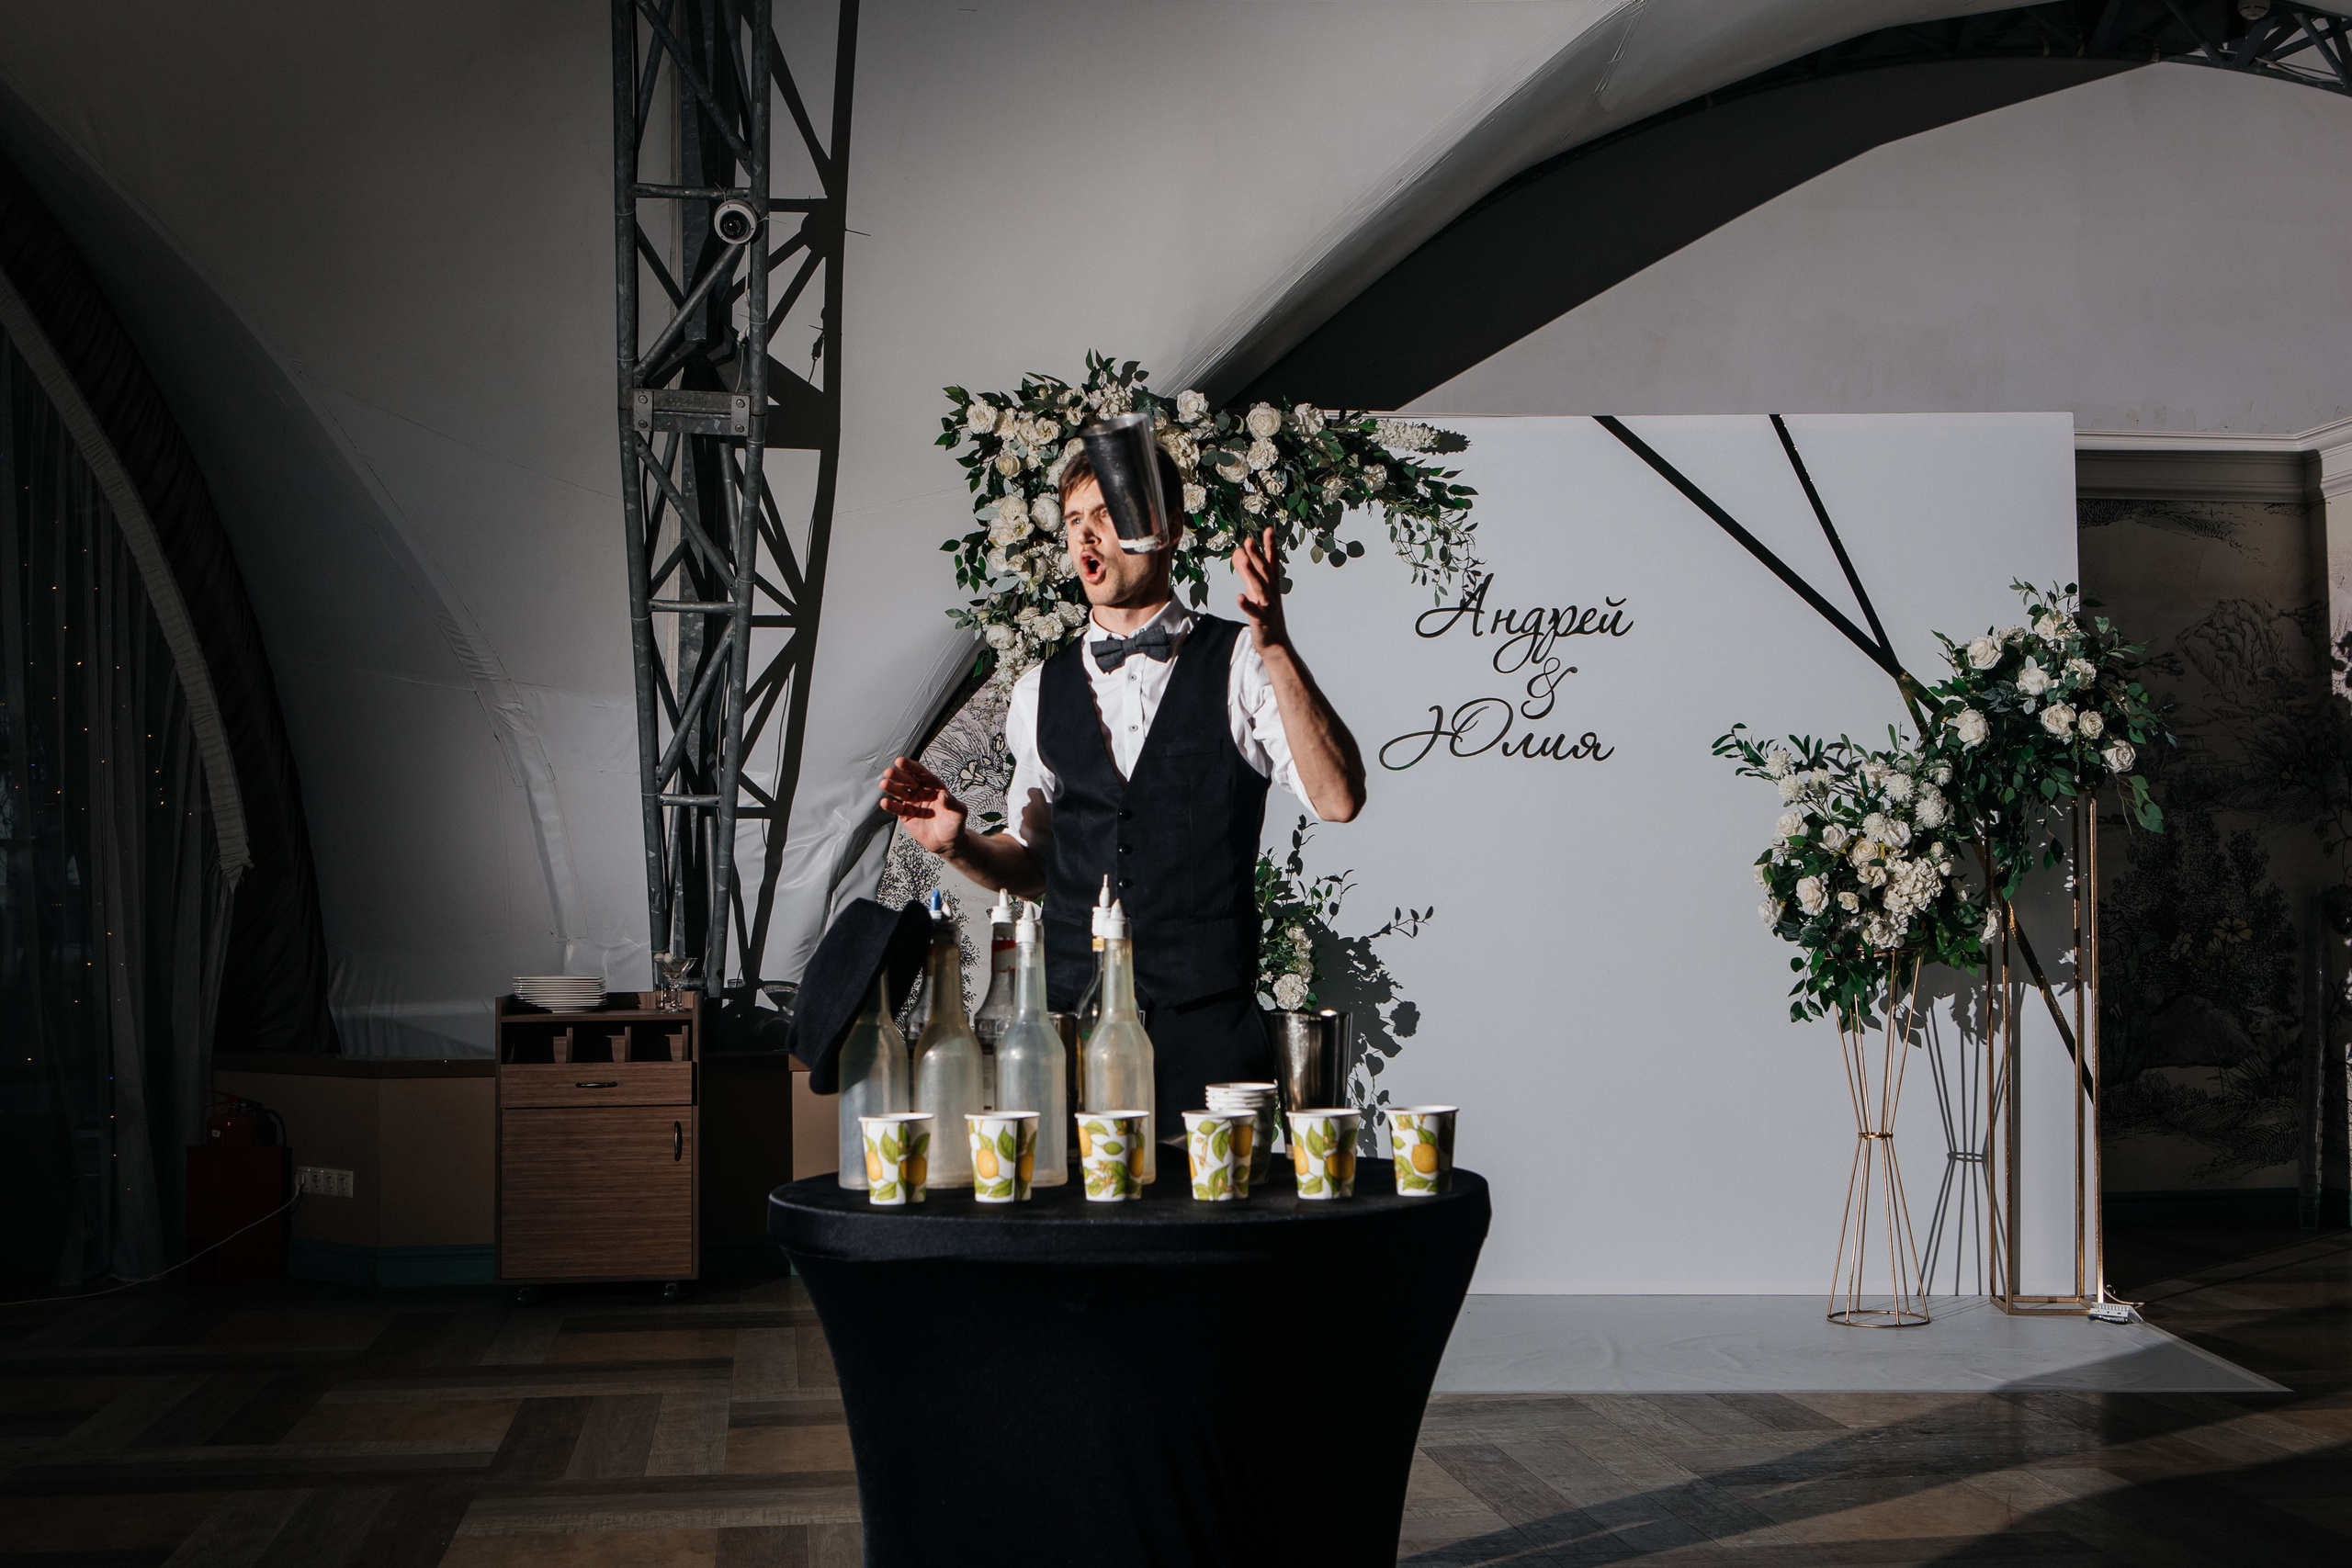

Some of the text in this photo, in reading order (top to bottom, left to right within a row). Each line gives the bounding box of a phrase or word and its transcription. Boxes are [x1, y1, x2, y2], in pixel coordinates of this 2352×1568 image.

[1415, 573, 1634, 673] Андрей
[1521, 657, 1577, 720] &
[1379, 698, 1614, 771] Юлия
